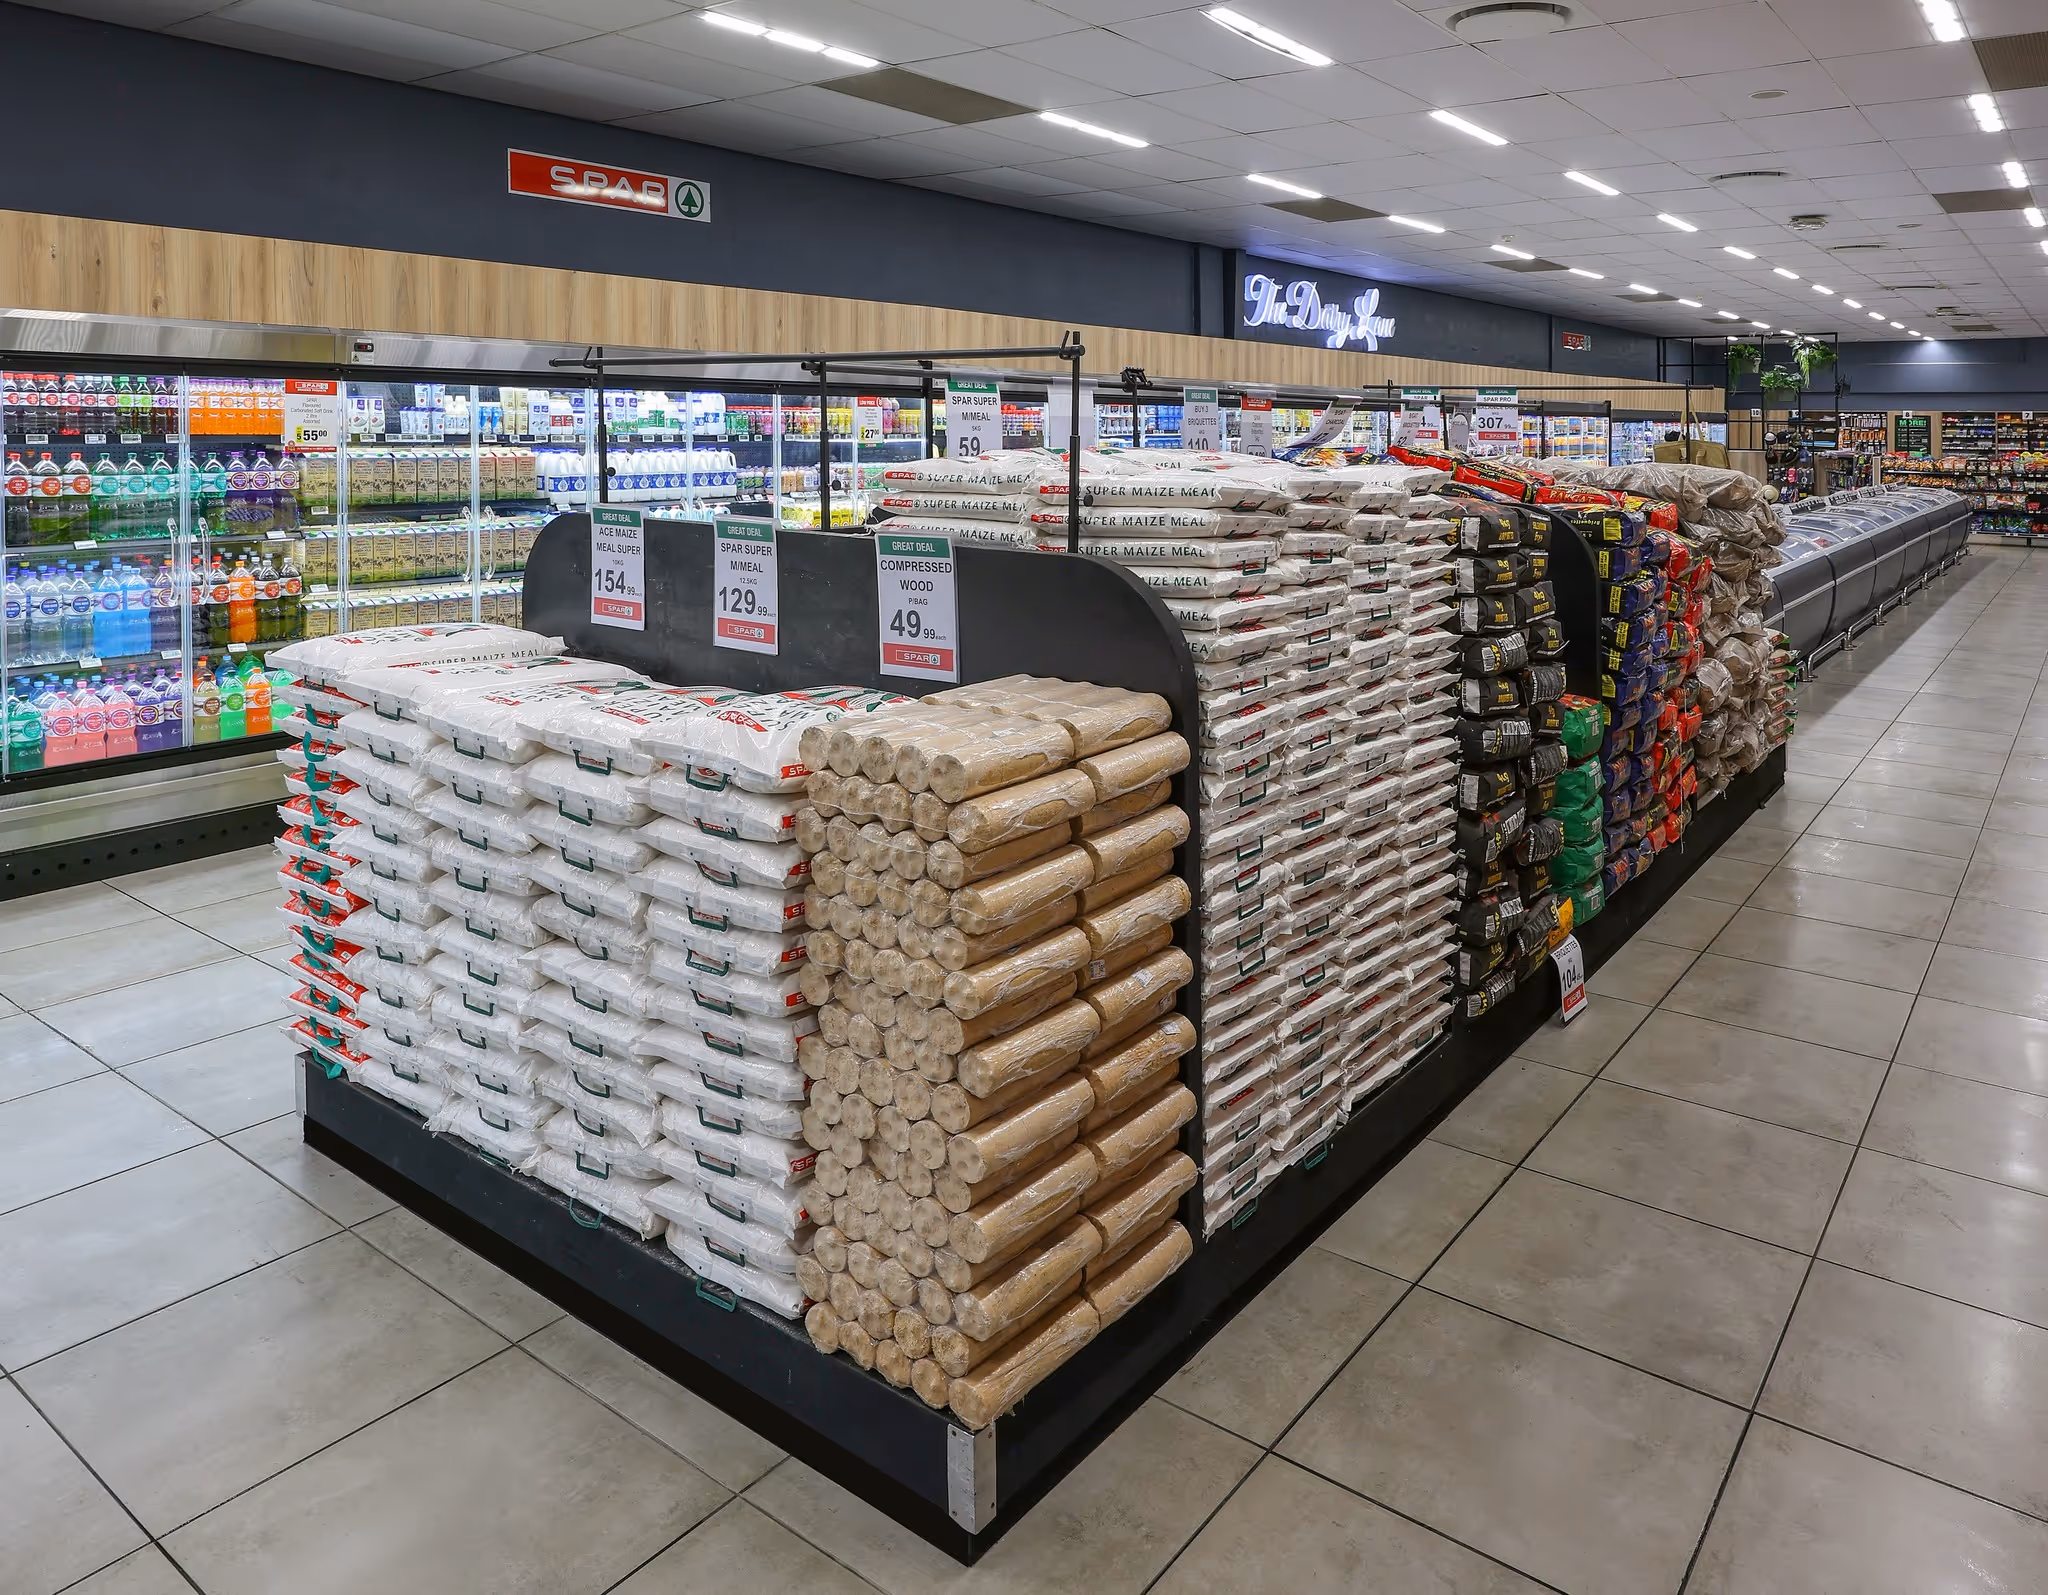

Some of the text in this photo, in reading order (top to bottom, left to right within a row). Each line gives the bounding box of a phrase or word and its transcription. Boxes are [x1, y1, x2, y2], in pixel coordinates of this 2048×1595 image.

[550, 165, 666, 208] SPAR
[1244, 274, 1288, 327] The
[1350, 288, 1397, 351] Lane
[952, 396, 998, 406] SPAR SUPER
[962, 412, 991, 421] M/MEAL
[1188, 418, 1217, 426] BRIQUETTES
[1478, 417, 1504, 429] 307
[303, 430, 318, 441] 55
[865, 429, 874, 438] 27
[959, 437, 981, 457] 59
[1188, 438, 1209, 450] 110
[928, 474, 963, 483] SUPER
[968, 475, 1003, 485] MAIZE
[1007, 474, 1031, 484] MEA
[1085, 486, 1126, 496] SUPER
[1132, 487, 1175, 497] MAIZE
[923, 500, 957, 509] SUPER
[961, 501, 997, 511] MAIZE
[1002, 502, 1027, 512] MEA
[602, 513, 632, 522] GREAT DEAL
[1038, 515, 1206, 527] SPAR SUPER MAIZE MEAL
[599, 527, 638, 539] ACE MAIZE
[727, 526, 762, 536] GREAT DEAL
[959, 530, 996, 541] MAIZE
[1000, 532, 1024, 543] MEA
[596, 542, 641, 555] MEAL SUPER
[720, 542, 772, 556] SPAR SUPER
[892, 541, 936, 552] GREAT DEAL
[1079, 546, 1118, 556] SUPER
[1123, 547, 1166, 556] MAIZE
[1171, 547, 1206, 557] MEAL
[730, 560, 763, 573] M/MEAL
[880, 560, 952, 573] COMPRESSED
[594, 568, 626, 594] 154
[626, 586, 636, 596] 99
[739, 577, 758, 585] 12.5KG
[900, 579, 934, 592] WOOD
[719, 586, 756, 615] 129
[757, 606, 768, 616] 99
[908, 598, 928, 606] P/BAG
[607, 605, 626, 613] SPAR
[1180, 611, 1211, 621] MEA
[890, 609, 921, 638] 49
[923, 628, 936, 640] 99
[733, 626, 756, 637] SPAR
[511, 648, 540, 659] MEAL
[903, 652, 930, 663] SPAR
[789, 765, 807, 777] SP
[792, 902, 805, 915] SP
[789, 947, 807, 959] SP
[1554, 940, 1578, 960] BRIQUETTES
[1562, 965, 1577, 992] 104
[796, 1156, 815, 1170] SP
